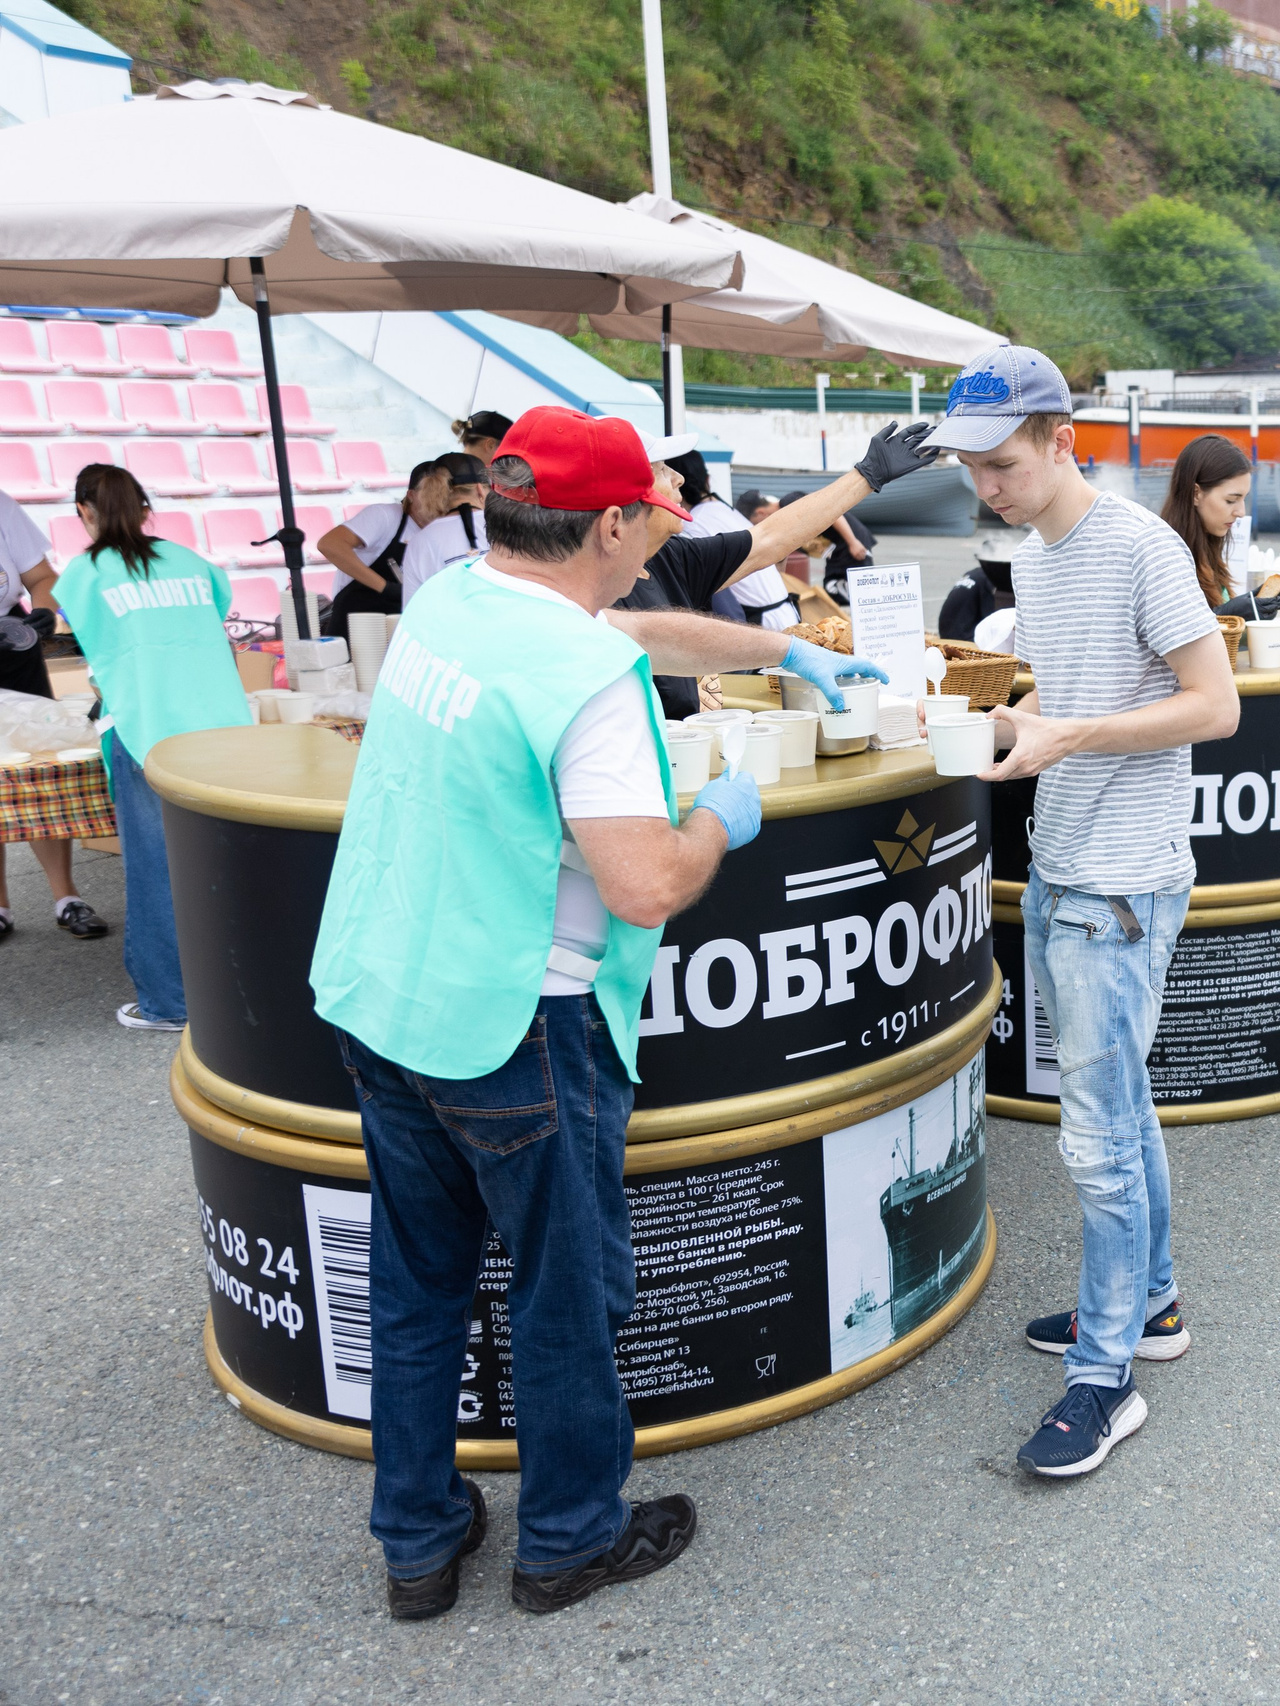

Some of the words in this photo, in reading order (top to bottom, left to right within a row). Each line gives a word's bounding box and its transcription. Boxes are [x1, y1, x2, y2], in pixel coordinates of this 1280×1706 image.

[1210, 1023, 1227, 1031] (423)
[1228, 1019, 1259, 1029] 230-26-70
[1166, 1072, 1198, 1080] 230-80-30
[1171, 1089, 1202, 1097] 7452-97
[641, 1180, 684, 1193] специи.
[686, 1173, 719, 1186] Масса
[721, 1166, 753, 1179] нетто:
[755, 1159, 772, 1172] 245
[688, 1185, 706, 1196] 100
[716, 1175, 762, 1192] (средние
[630, 1200, 697, 1217] лорийность
[712, 1192, 729, 1203] 261
[733, 1187, 758, 1199] ккал.
[760, 1180, 784, 1192] Срок
[675, 1212, 696, 1222] при
[697, 1197, 760, 1217] температуре
[630, 1223, 688, 1240] влажности
[692, 1215, 733, 1229] воздуха
[735, 1211, 747, 1220] не
[750, 1203, 779, 1217] более
[781, 1195, 803, 1209] 75%.
[745, 1217, 784, 1235] РЫБЫ.
[219, 1218, 249, 1266] 08
[256, 1238, 300, 1284] 24
[678, 1245, 715, 1260] банки
[718, 1244, 725, 1252] в
[728, 1232, 772, 1248] первом
[775, 1224, 804, 1240] ряду.
[641, 1270, 648, 1278] к
[651, 1251, 746, 1278] употреблению.
[713, 1268, 752, 1284] 692954,
[754, 1259, 790, 1275] Россия,
[701, 1289, 716, 1300] ул.
[718, 1275, 772, 1295] Заводская,
[774, 1269, 787, 1280] 16.
[624, 1307, 674, 1322] 30-26-70
[676, 1301, 702, 1315] (доб.
[704, 1295, 729, 1308] 256).
[659, 1320, 680, 1332] дне
[682, 1313, 713, 1326] банки
[716, 1310, 728, 1319] во
[731, 1300, 767, 1315] втором
[769, 1292, 794, 1307] ряду.
[619, 1337, 680, 1352] Сибирцев»
[630, 1353, 661, 1364] завод
[664, 1349, 675, 1359] №
[678, 1346, 691, 1355] 13
[618, 1361, 687, 1379] имрыбснаб»,
[632, 1376, 658, 1389] (495)
[660, 1366, 711, 1383] 781-44-14.
